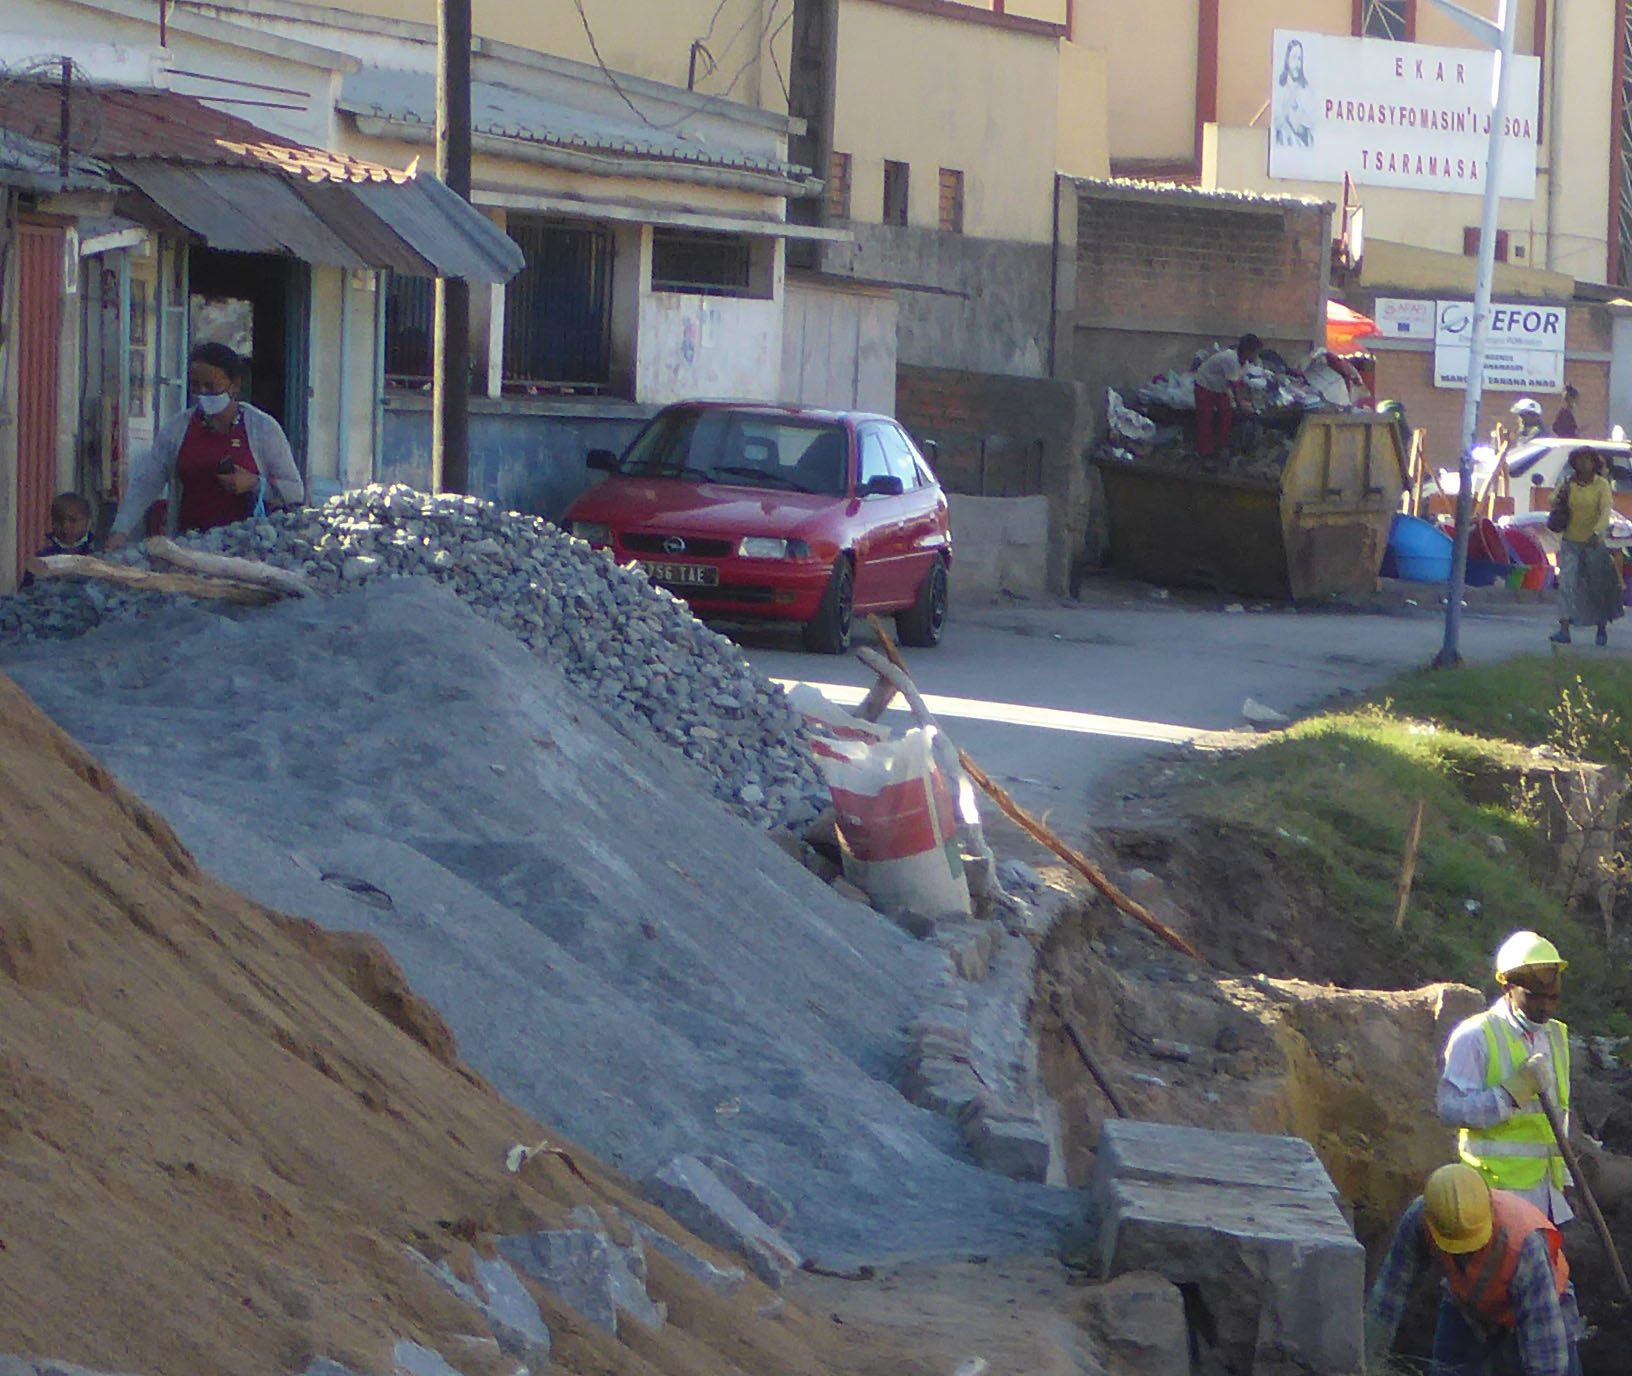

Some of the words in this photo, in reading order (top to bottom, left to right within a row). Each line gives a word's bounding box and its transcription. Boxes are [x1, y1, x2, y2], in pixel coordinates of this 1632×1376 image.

[1395, 57, 1465, 84] EKAR
[1482, 114, 1531, 139] JSOA
[1362, 150, 1489, 180] TSARAMASA
[1488, 305, 1560, 334] EFOR
